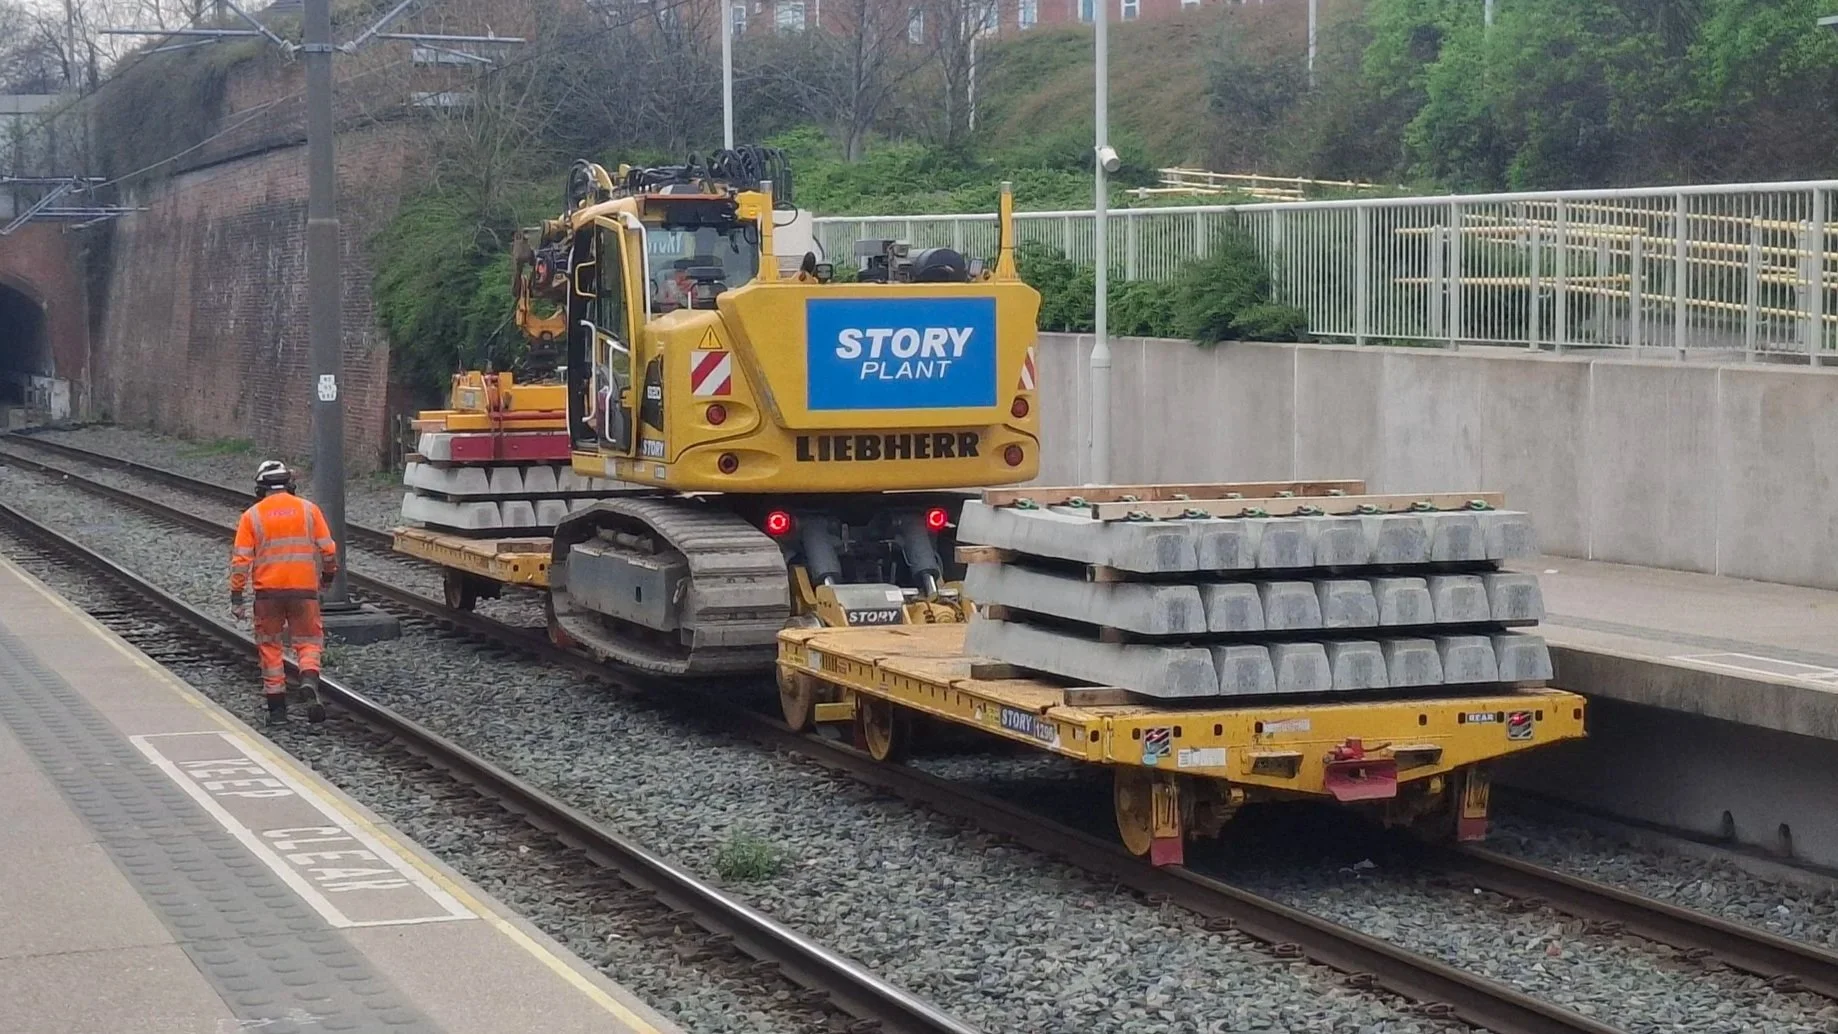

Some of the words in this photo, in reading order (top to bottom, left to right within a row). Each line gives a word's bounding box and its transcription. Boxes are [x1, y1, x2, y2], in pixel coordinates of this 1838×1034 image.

[836, 327, 974, 359] STORY
[860, 360, 952, 380] PLANT
[643, 440, 664, 457] STORY
[796, 432, 980, 462] LIEBHERR
[849, 610, 898, 623] STORY
[1001, 708, 1033, 732] STORY
[178, 758, 296, 798] KEEP
[262, 826, 412, 892] CLEAR
